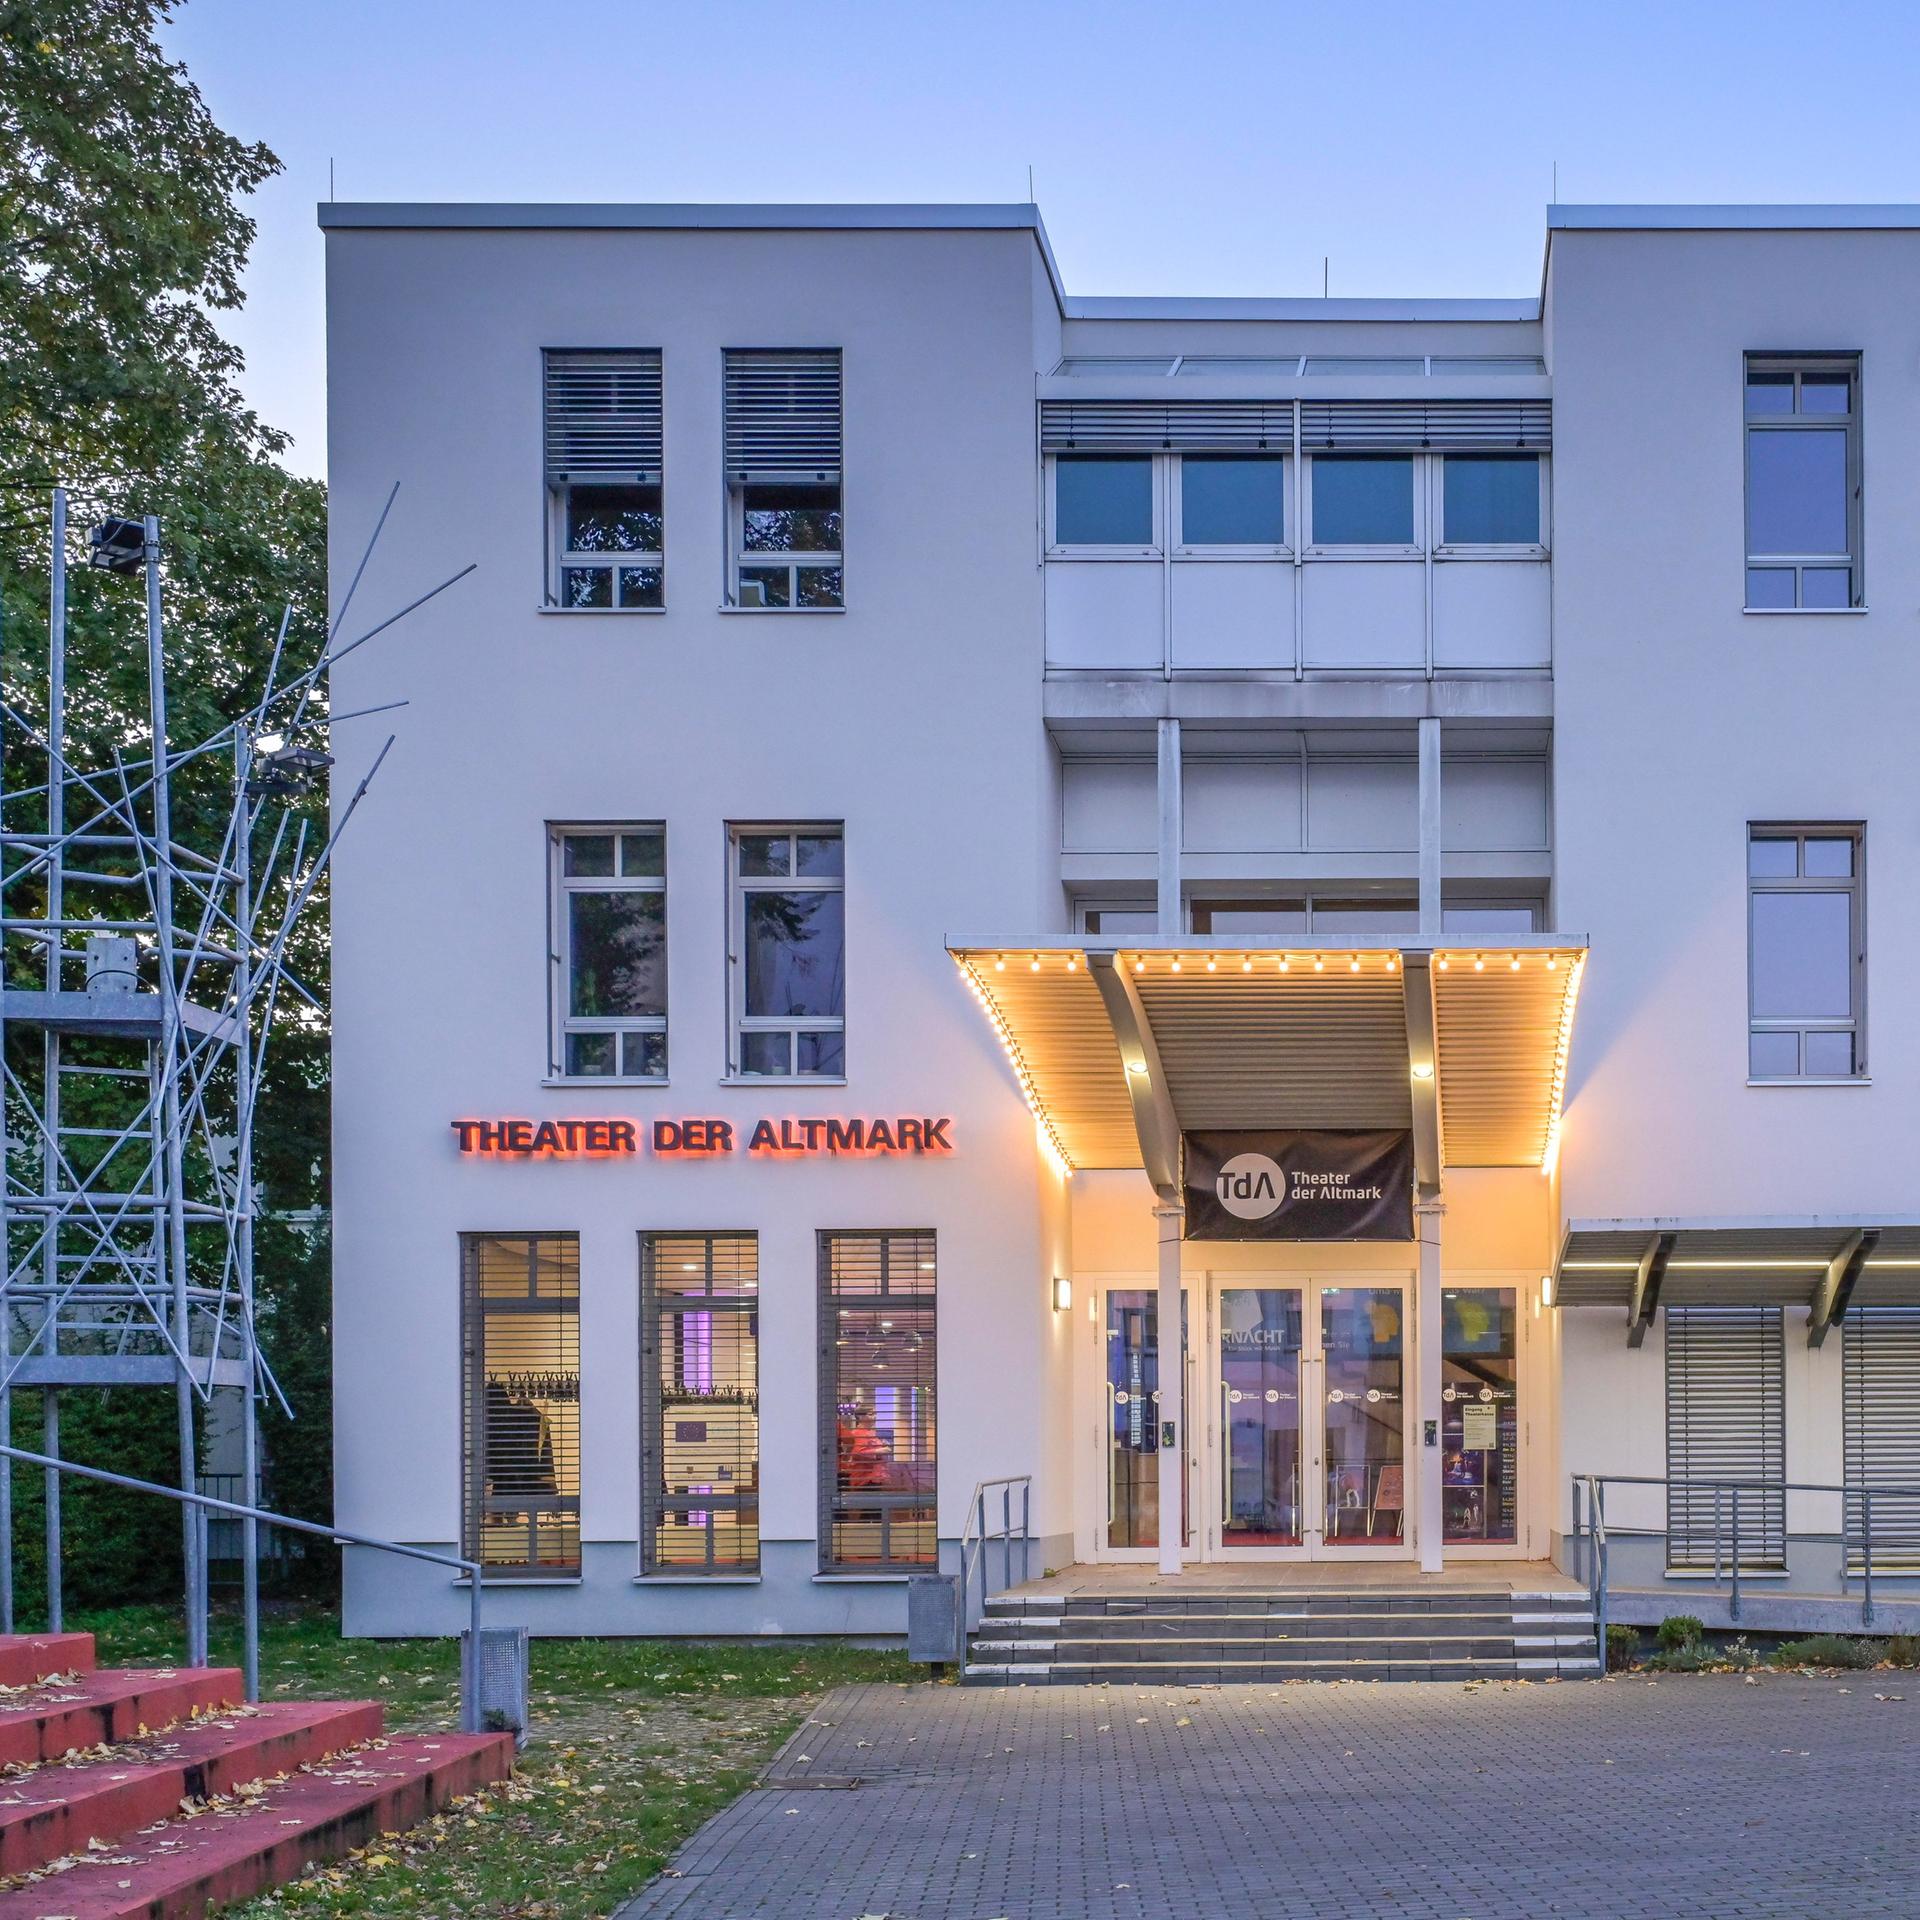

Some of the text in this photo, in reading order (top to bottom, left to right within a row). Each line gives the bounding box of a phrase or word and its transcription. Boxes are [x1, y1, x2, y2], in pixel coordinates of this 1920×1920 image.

[451, 1118, 953, 1153] THEATER DER ALTMARK
[1218, 1172, 1277, 1200] TdA
[1291, 1171, 1351, 1185] Theater
[1291, 1186, 1382, 1200] der Altmark
